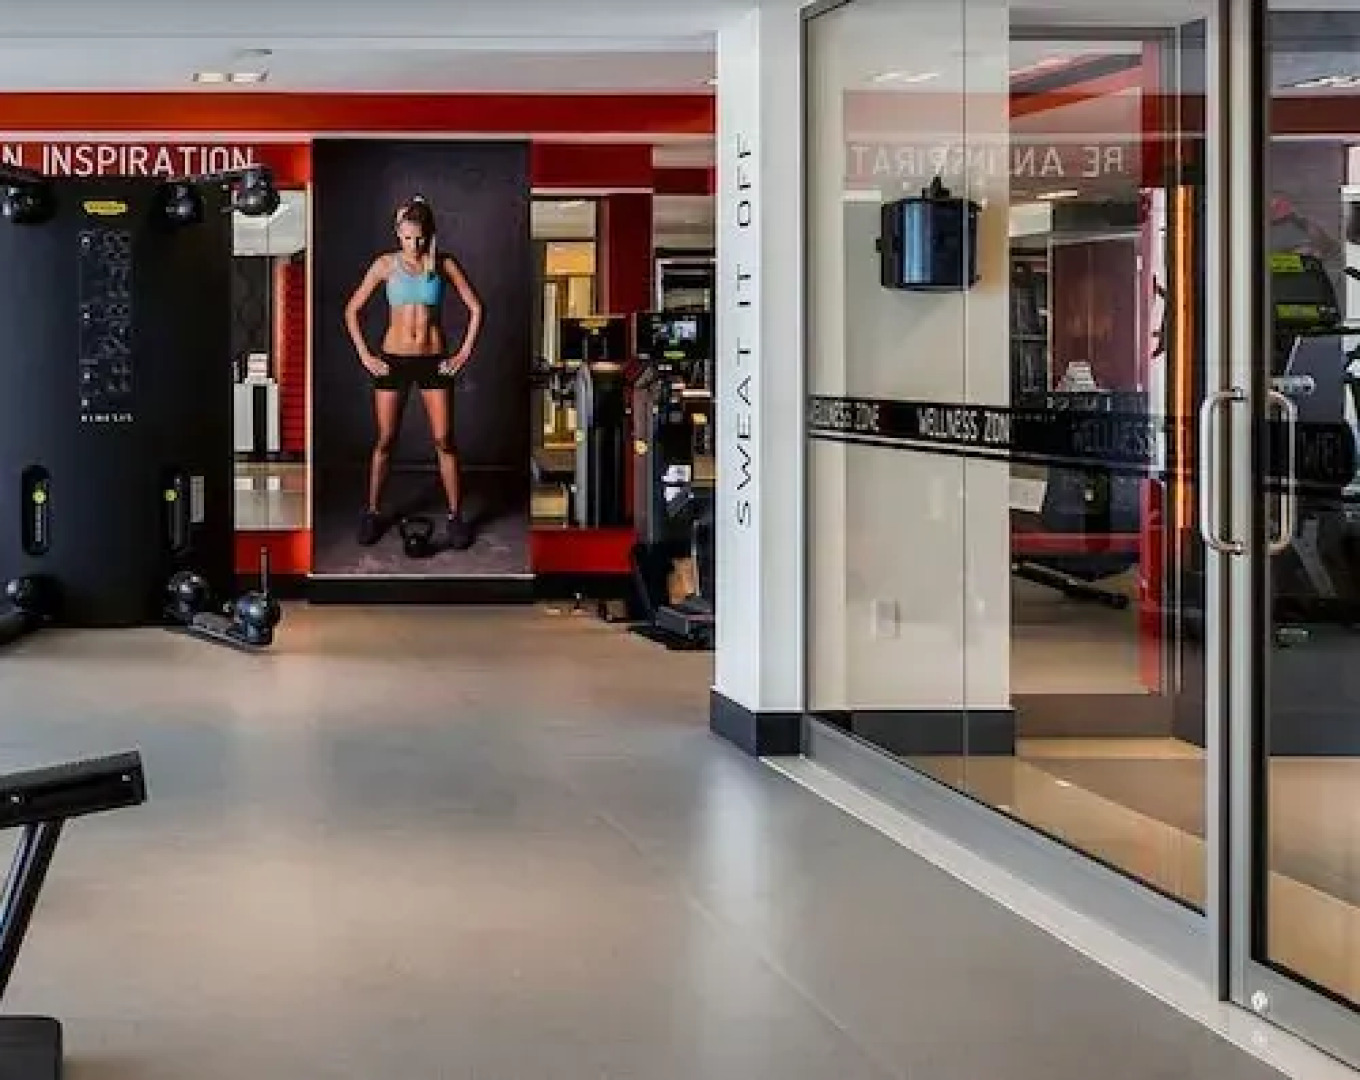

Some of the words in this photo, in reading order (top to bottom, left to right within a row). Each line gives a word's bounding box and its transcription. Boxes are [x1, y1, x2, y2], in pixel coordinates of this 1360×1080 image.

[42, 145, 253, 177] INSPIRATION
[736, 132, 752, 229] OFF
[736, 263, 752, 308] IT
[736, 336, 752, 529] SWEAT
[916, 407, 978, 441] WELLNESS
